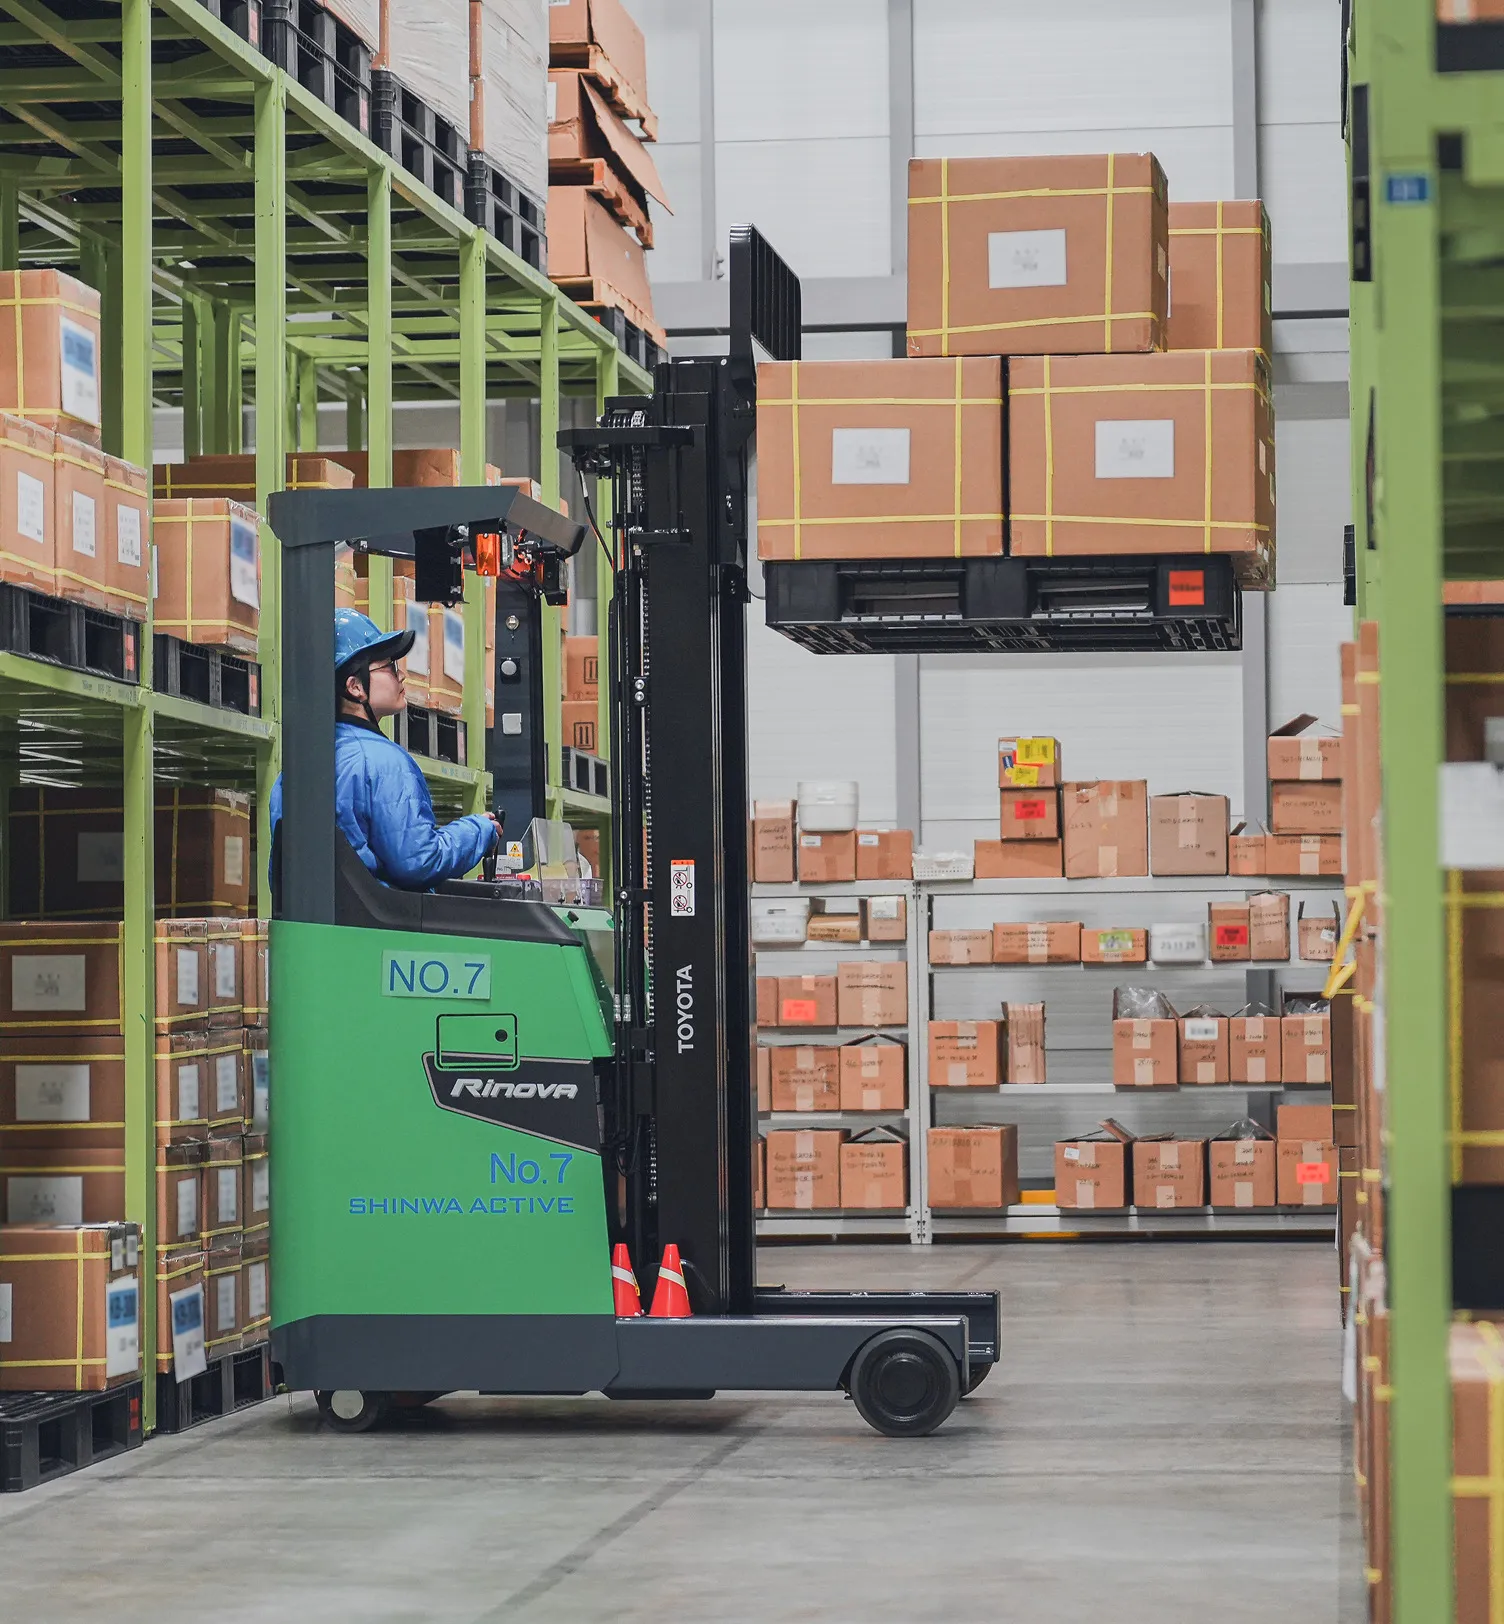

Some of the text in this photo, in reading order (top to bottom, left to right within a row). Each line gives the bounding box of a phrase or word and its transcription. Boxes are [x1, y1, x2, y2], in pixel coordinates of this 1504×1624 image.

[389, 960, 486, 994] NO.7
[676, 964, 694, 1054] TOYOTA
[491, 1153, 573, 1184] No.7
[349, 1197, 574, 1214] SHINWA ACTIVE
